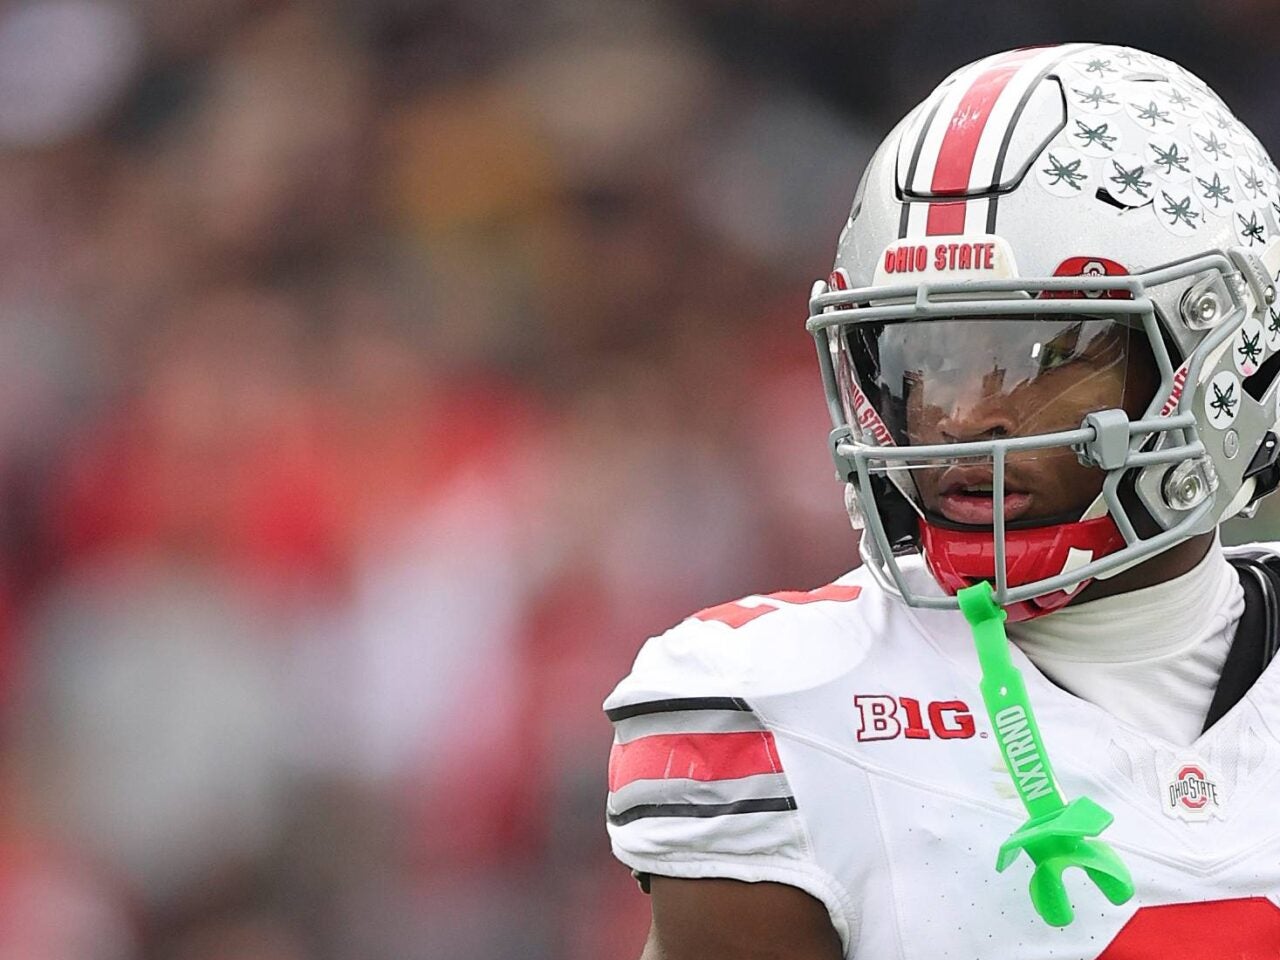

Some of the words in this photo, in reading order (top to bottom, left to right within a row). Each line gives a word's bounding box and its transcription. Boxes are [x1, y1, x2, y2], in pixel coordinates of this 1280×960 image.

[885, 244, 928, 275] OHIO
[934, 242, 995, 271] STATE
[995, 704, 1054, 802] NXTRND
